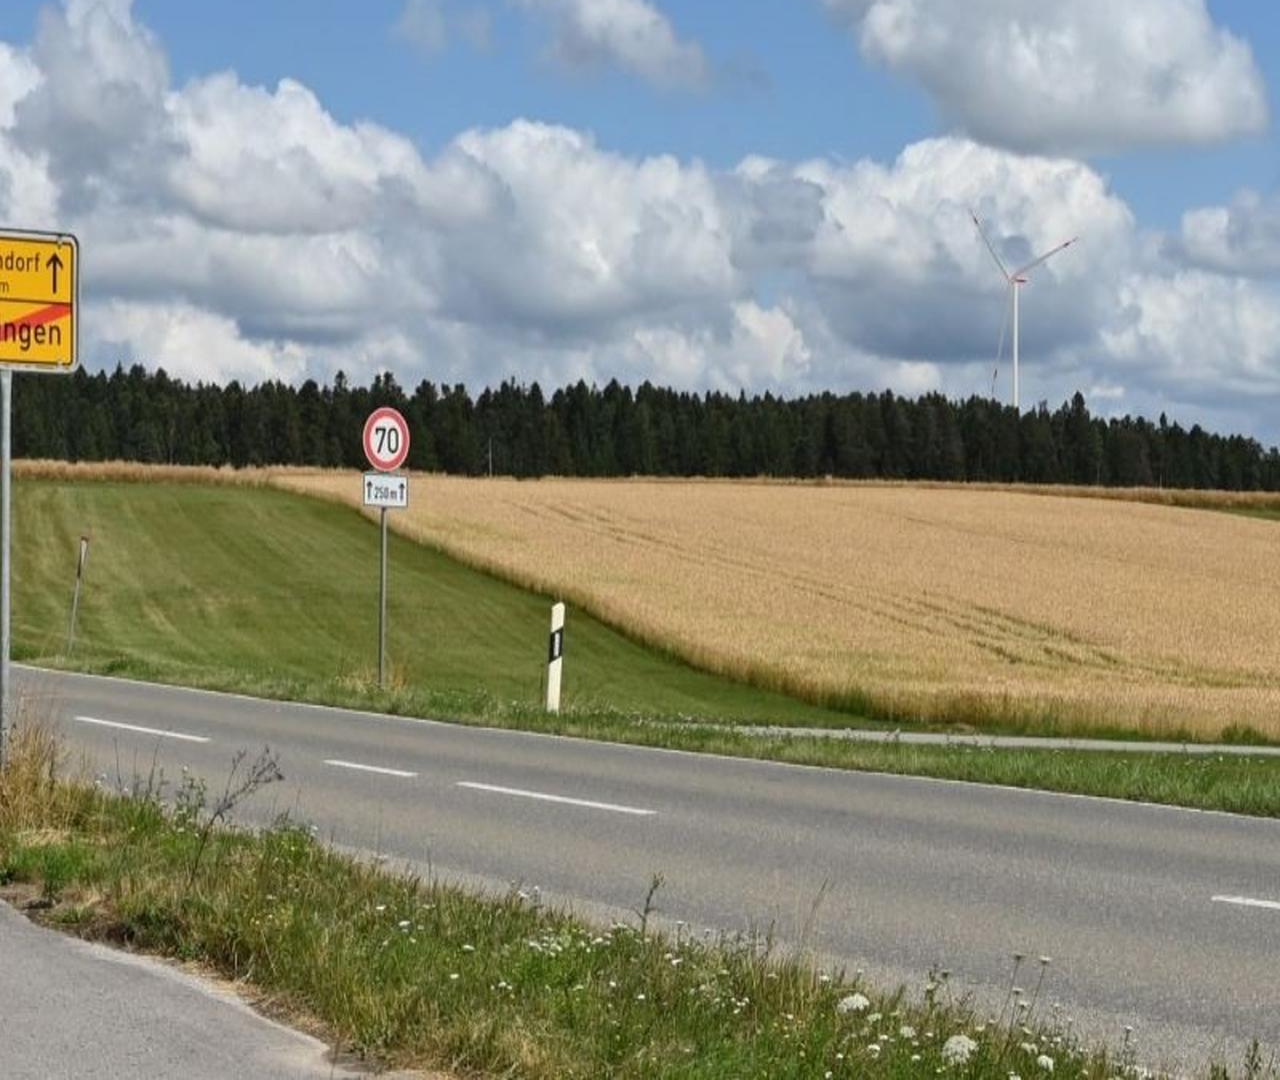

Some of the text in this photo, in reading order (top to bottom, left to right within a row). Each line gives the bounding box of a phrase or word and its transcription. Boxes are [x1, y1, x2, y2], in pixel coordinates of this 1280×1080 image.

[375, 427, 399, 453] 70
[374, 486, 397, 499] 250 m
